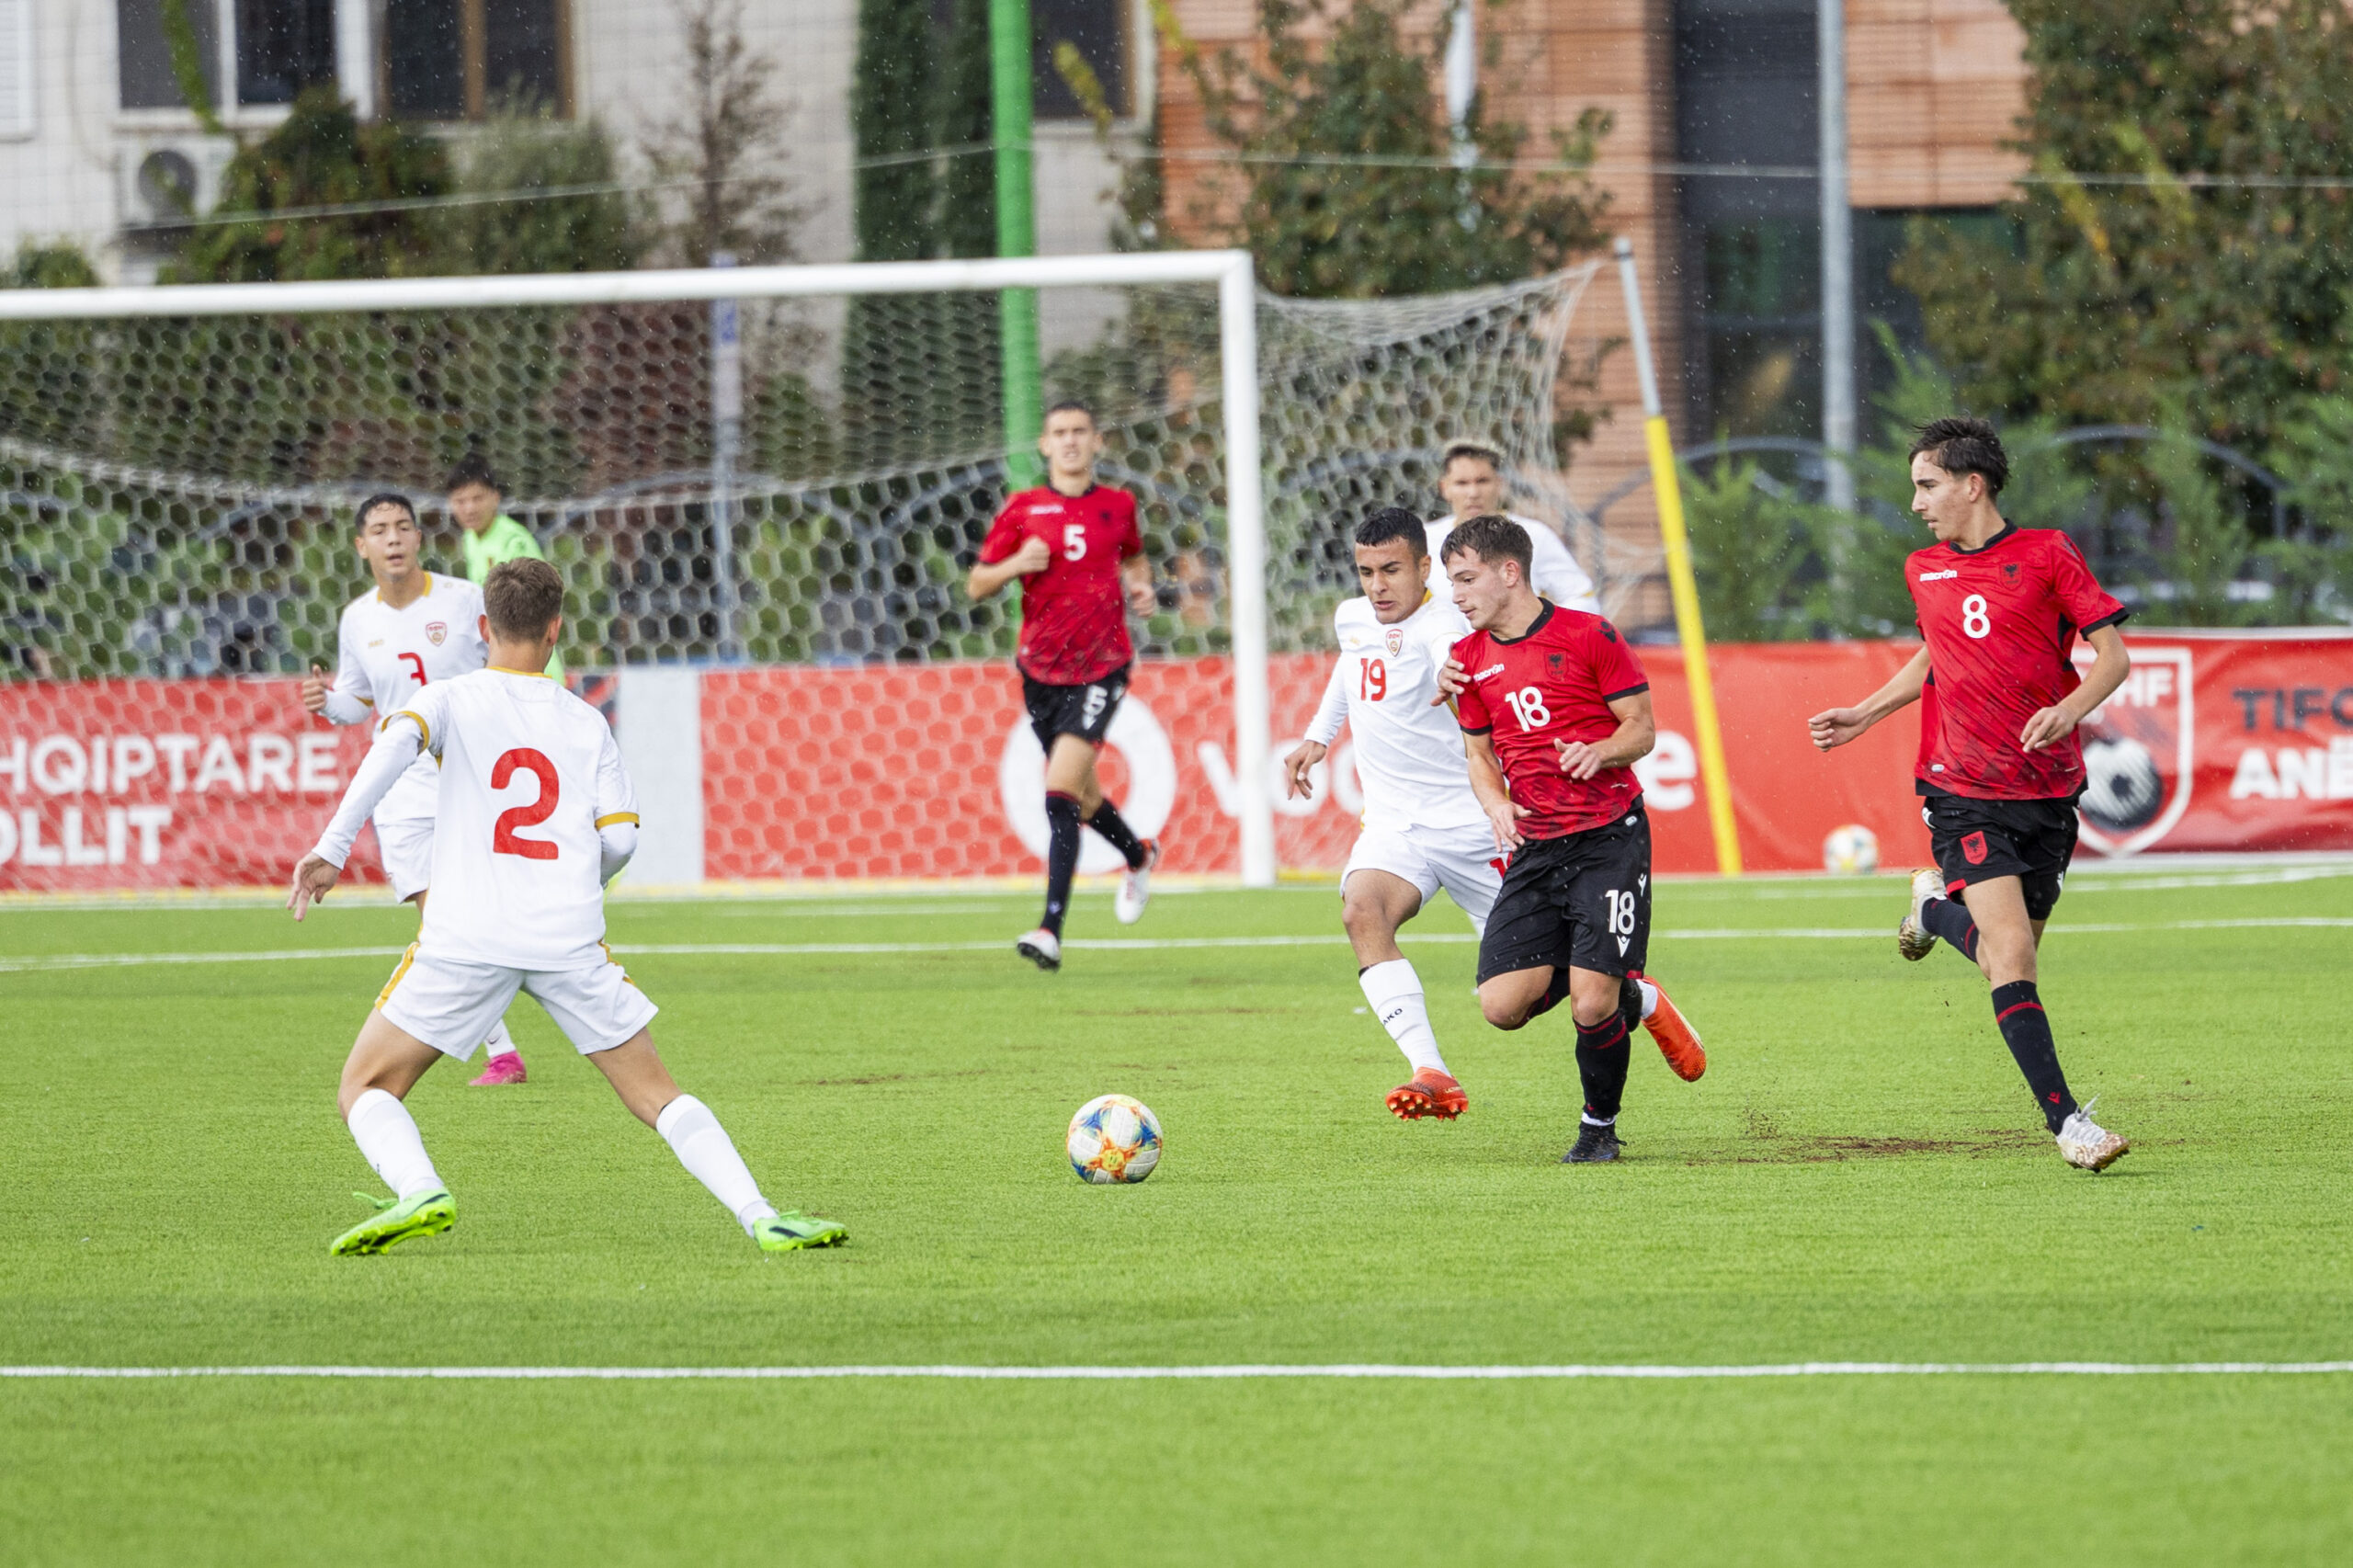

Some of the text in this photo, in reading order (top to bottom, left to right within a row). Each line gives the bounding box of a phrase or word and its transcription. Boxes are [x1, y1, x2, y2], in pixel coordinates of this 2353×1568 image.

[1063, 524, 1087, 562] 5
[1962, 594, 1991, 639] 8
[1083, 685, 1107, 716] 5
[1360, 658, 1387, 701] 19
[1505, 686, 1552, 733] 18
[491, 747, 559, 859] 2
[1606, 889, 1635, 935] 18
